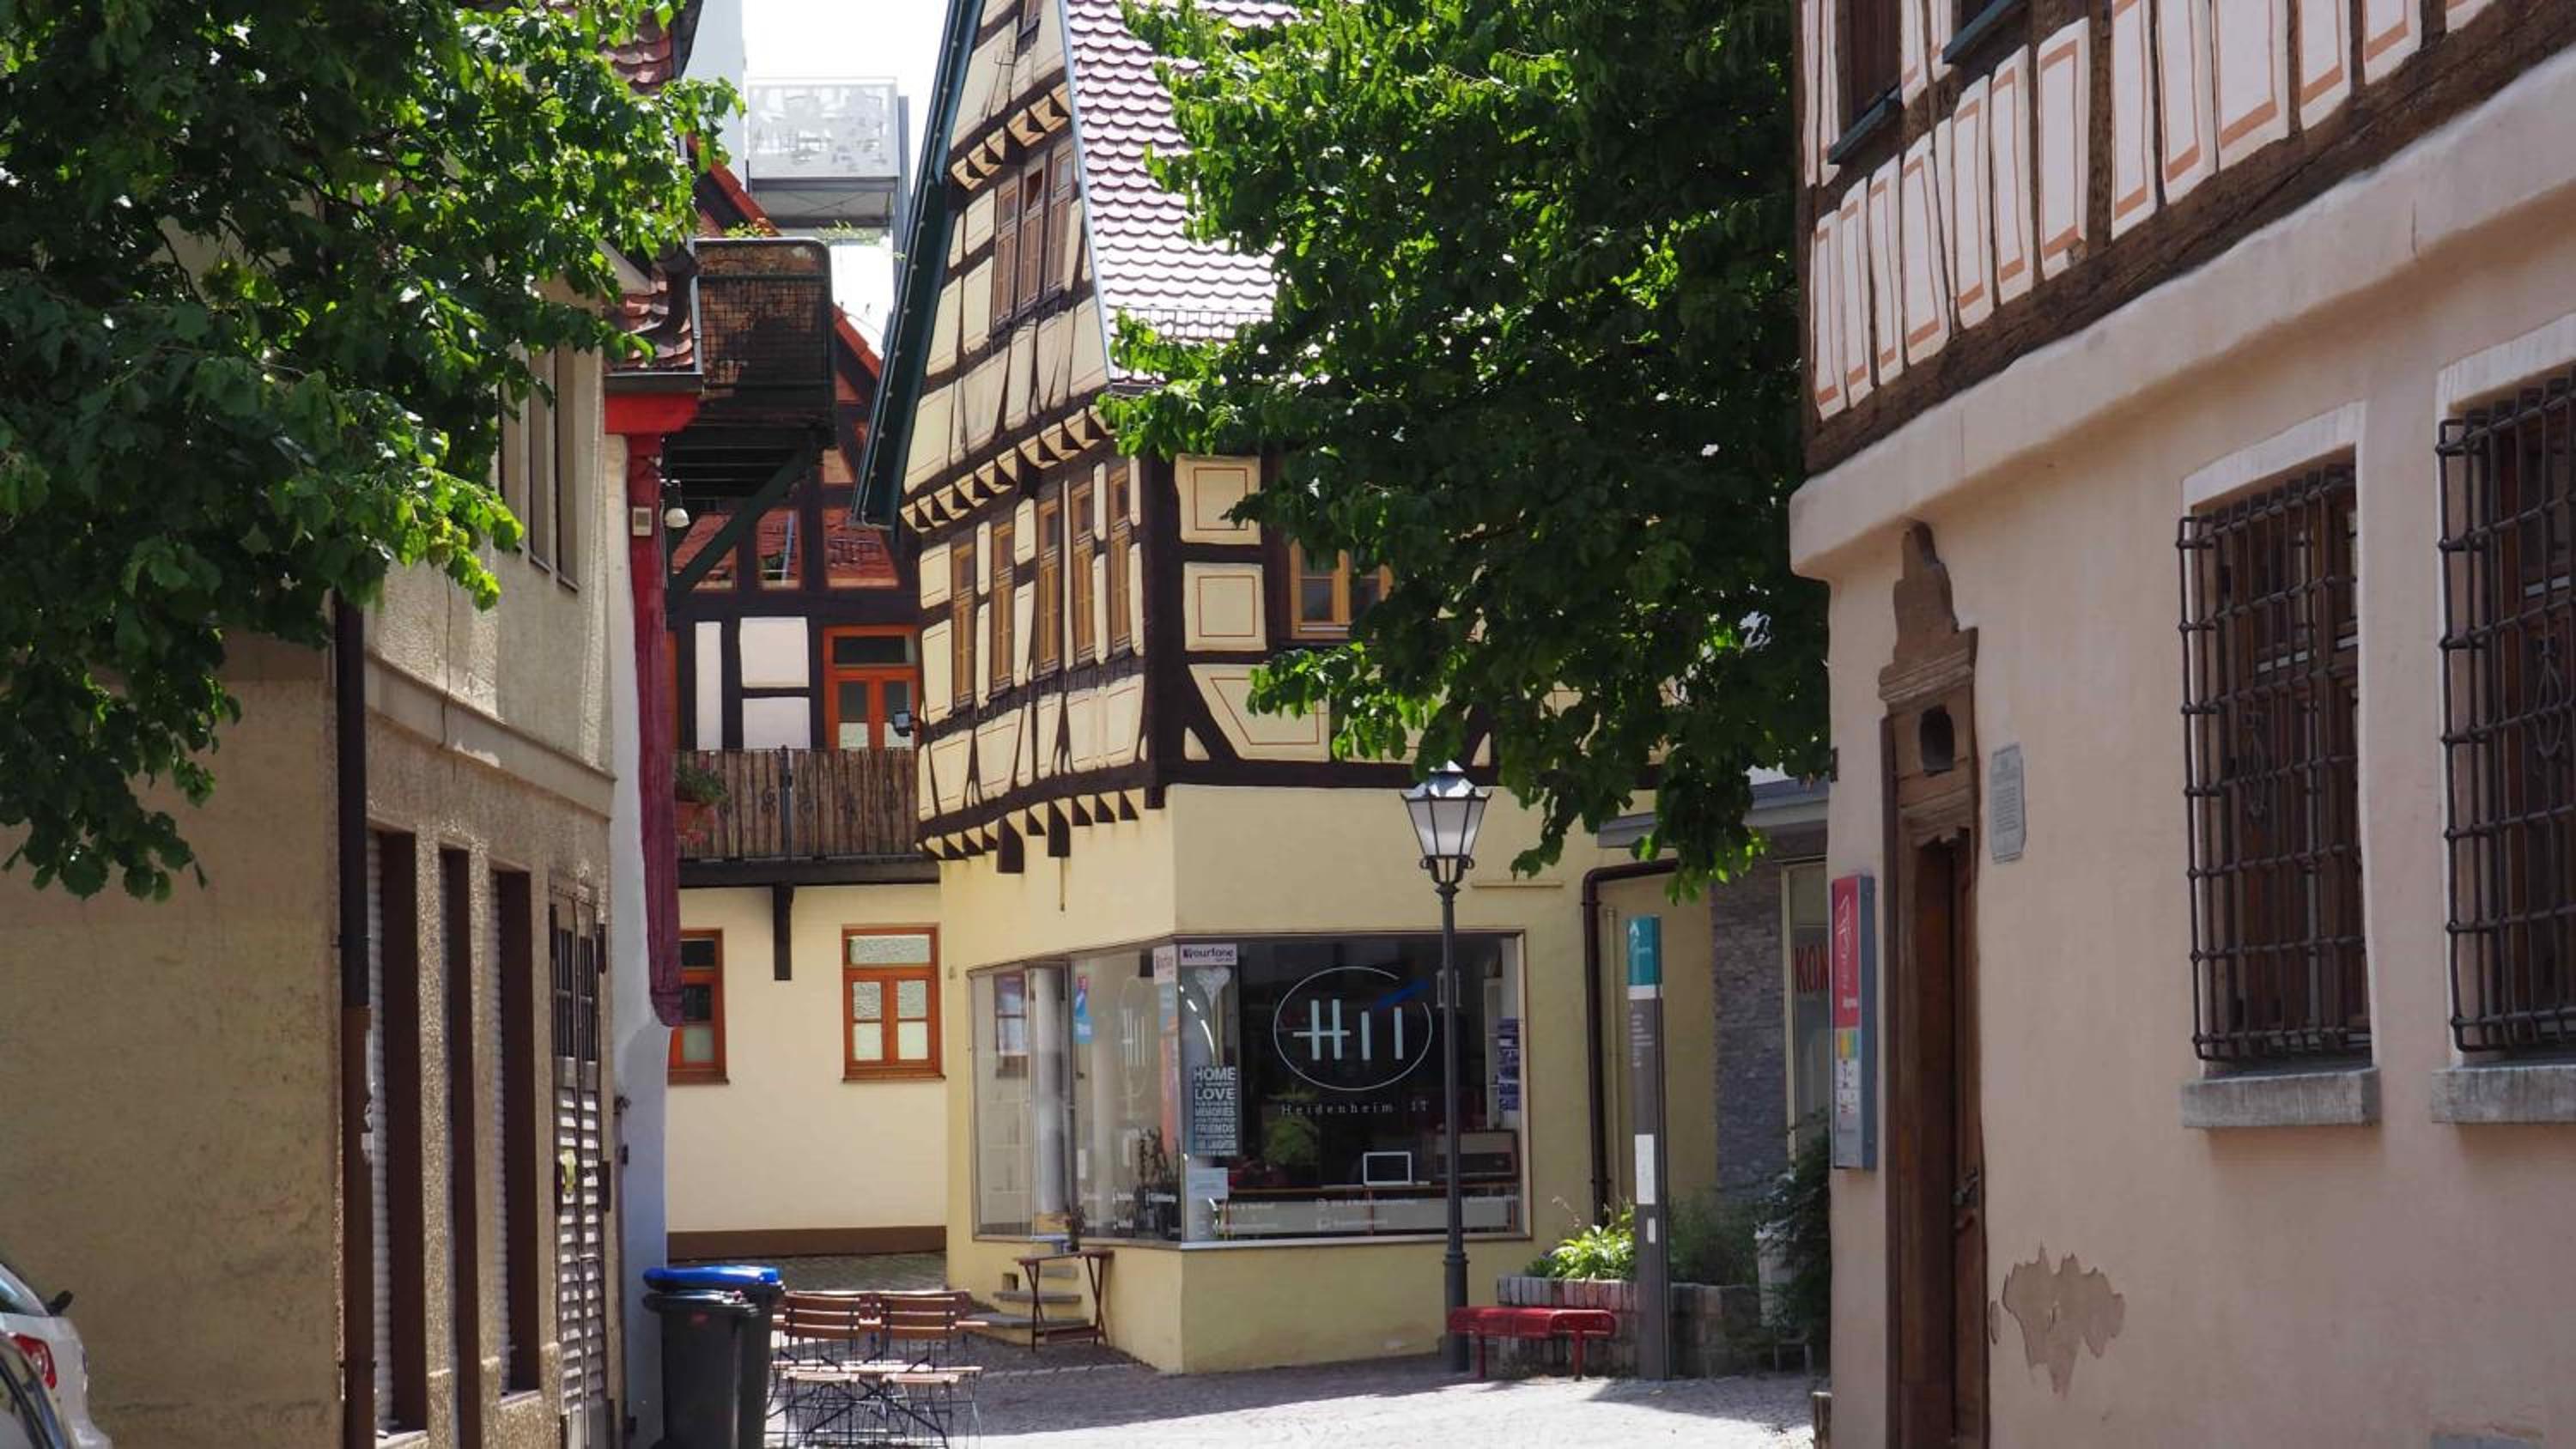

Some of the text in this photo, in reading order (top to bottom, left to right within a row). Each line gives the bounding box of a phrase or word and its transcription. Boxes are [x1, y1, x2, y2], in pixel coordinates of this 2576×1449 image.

[1194, 1067, 1236, 1081] HOME
[1195, 1088, 1236, 1100] LOVE
[1280, 1099, 1429, 1116] Heidenheim IT
[1195, 1124, 1236, 1134] FRIENDS
